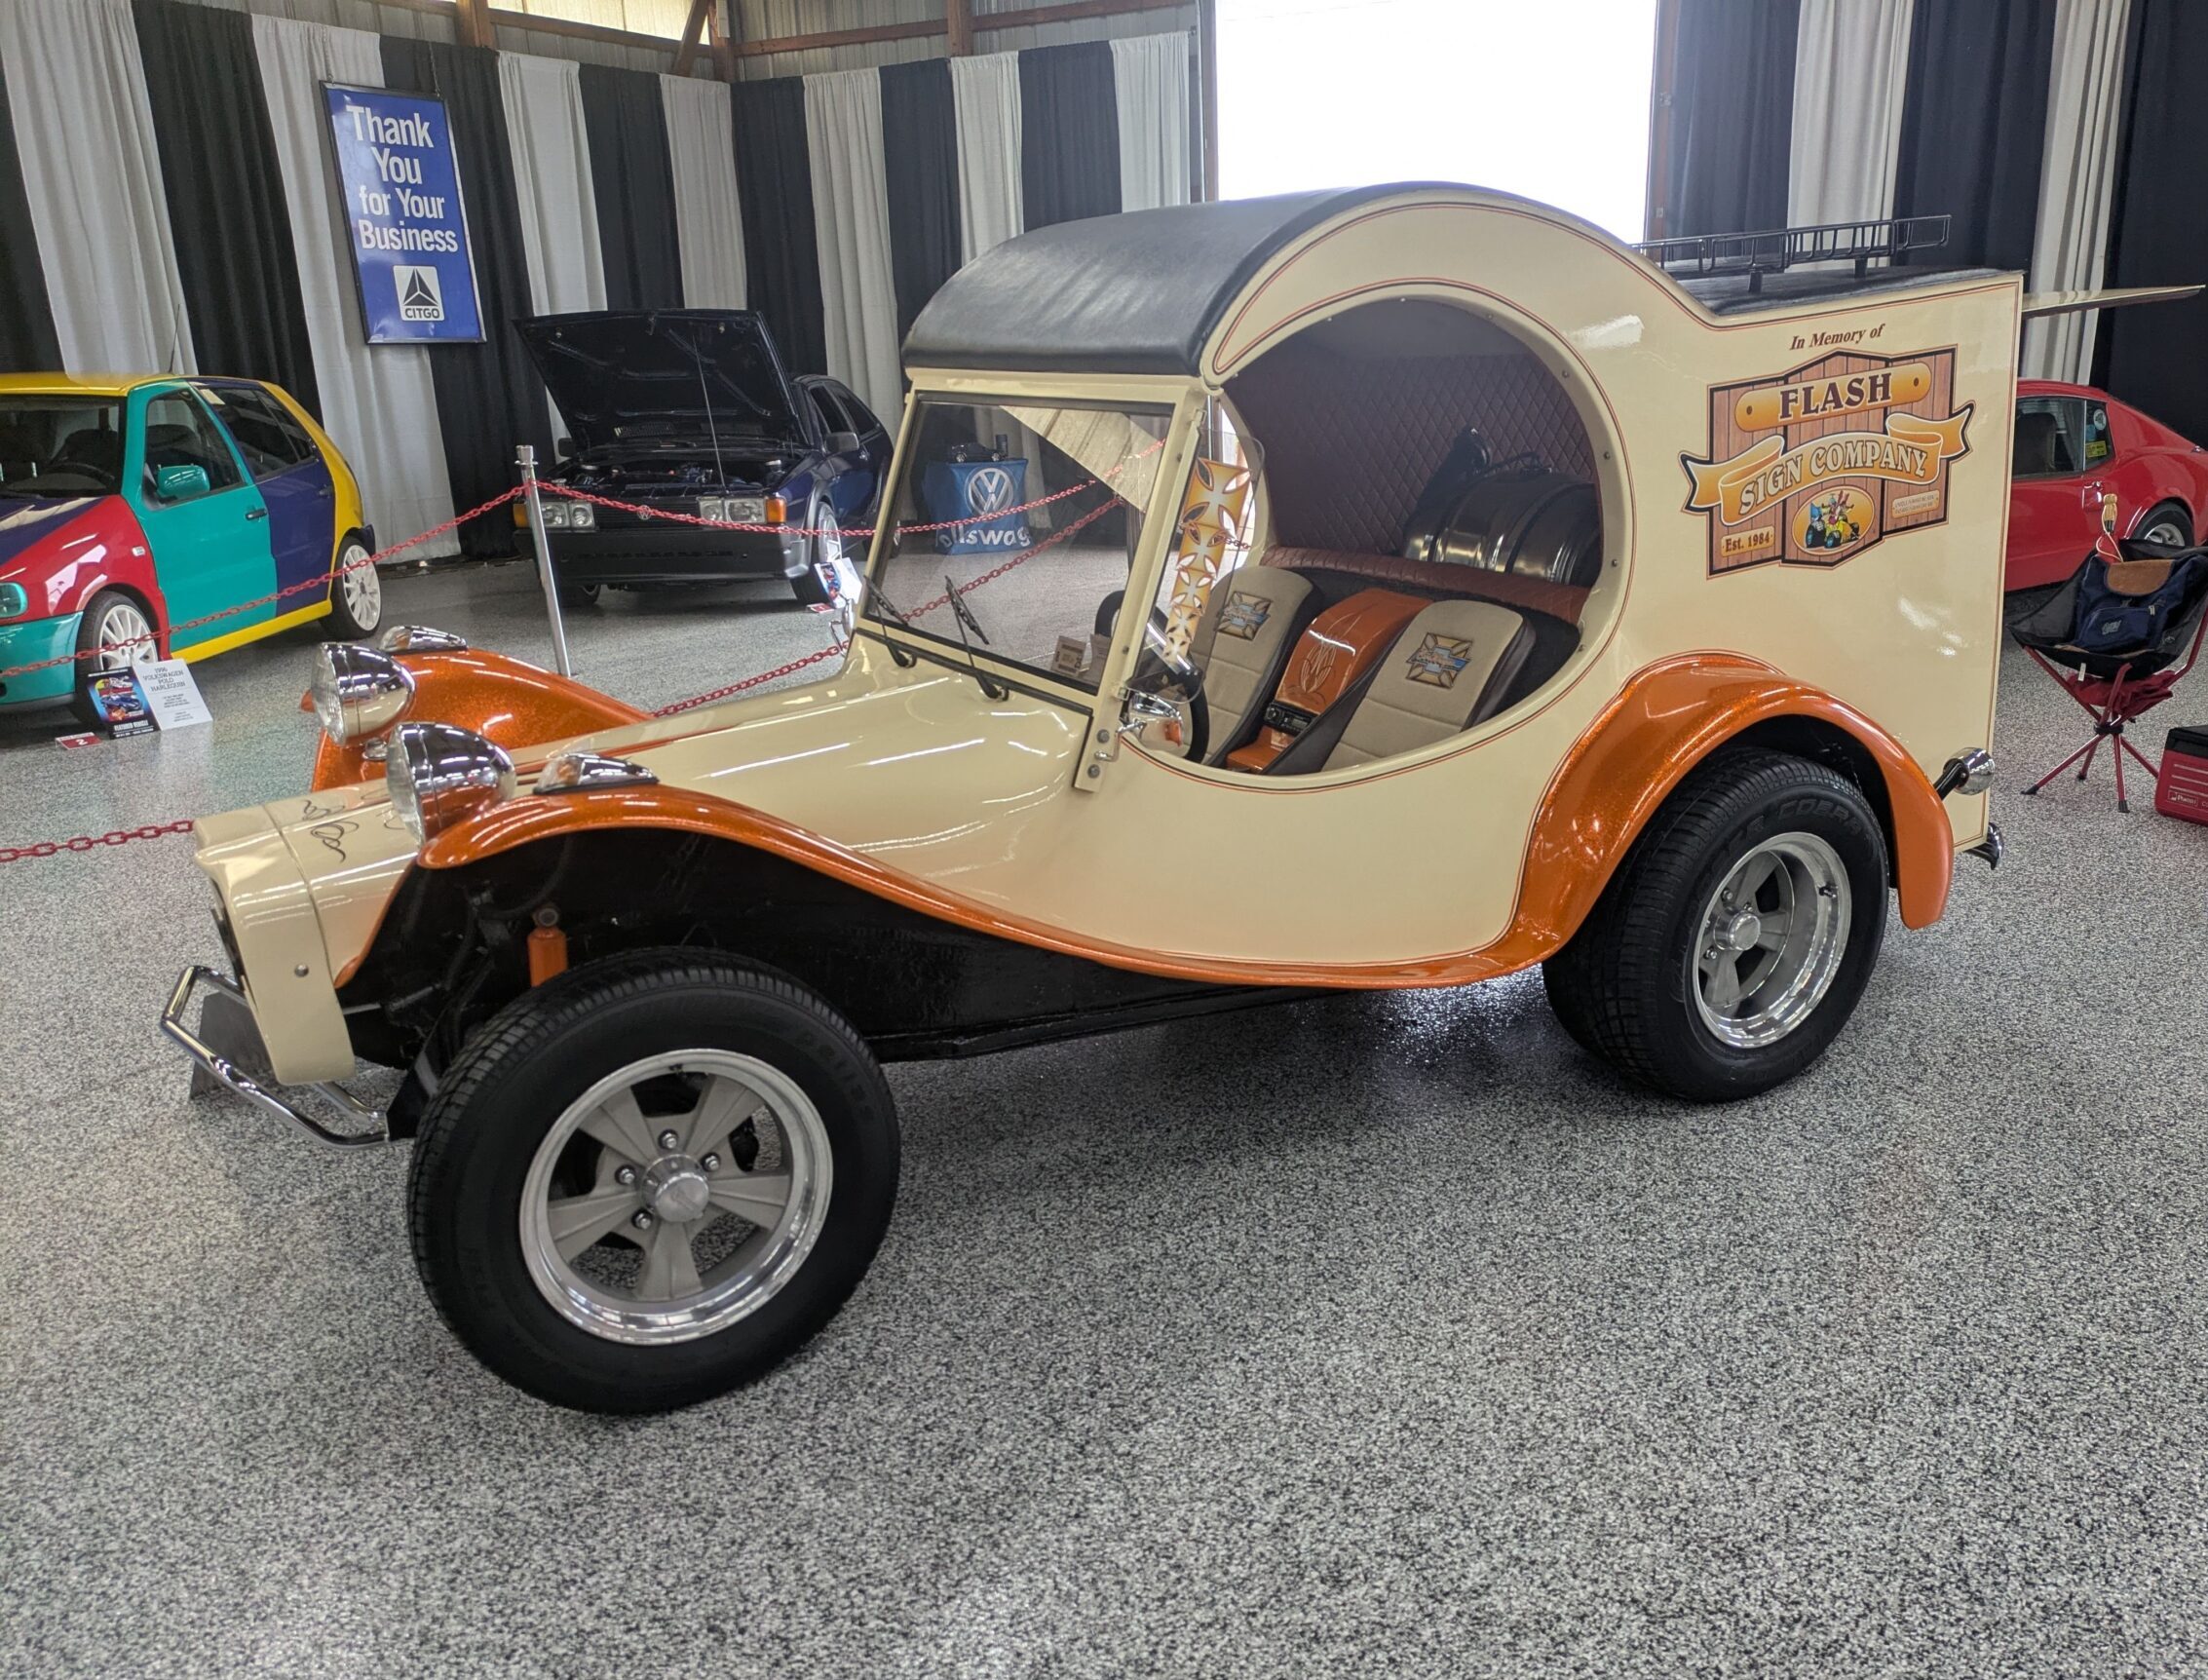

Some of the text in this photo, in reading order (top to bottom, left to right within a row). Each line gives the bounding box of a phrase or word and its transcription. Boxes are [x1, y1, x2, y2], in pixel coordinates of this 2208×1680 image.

[346, 105, 434, 148] Thank
[371, 147, 423, 185] You
[359, 185, 445, 219] for Your
[358, 219, 459, 252] Business
[404, 308, 439, 320] CITGO
[1790, 324, 1885, 351] In Memory of
[1779, 371, 1892, 420] FLASH
[1738, 439, 1927, 515] SIGN COMPANY
[1725, 531, 1770, 553] Est. 1984
[142, 670, 184, 680] VOLKSWAGEN
[151, 681, 186, 692] HARLEQUIN
